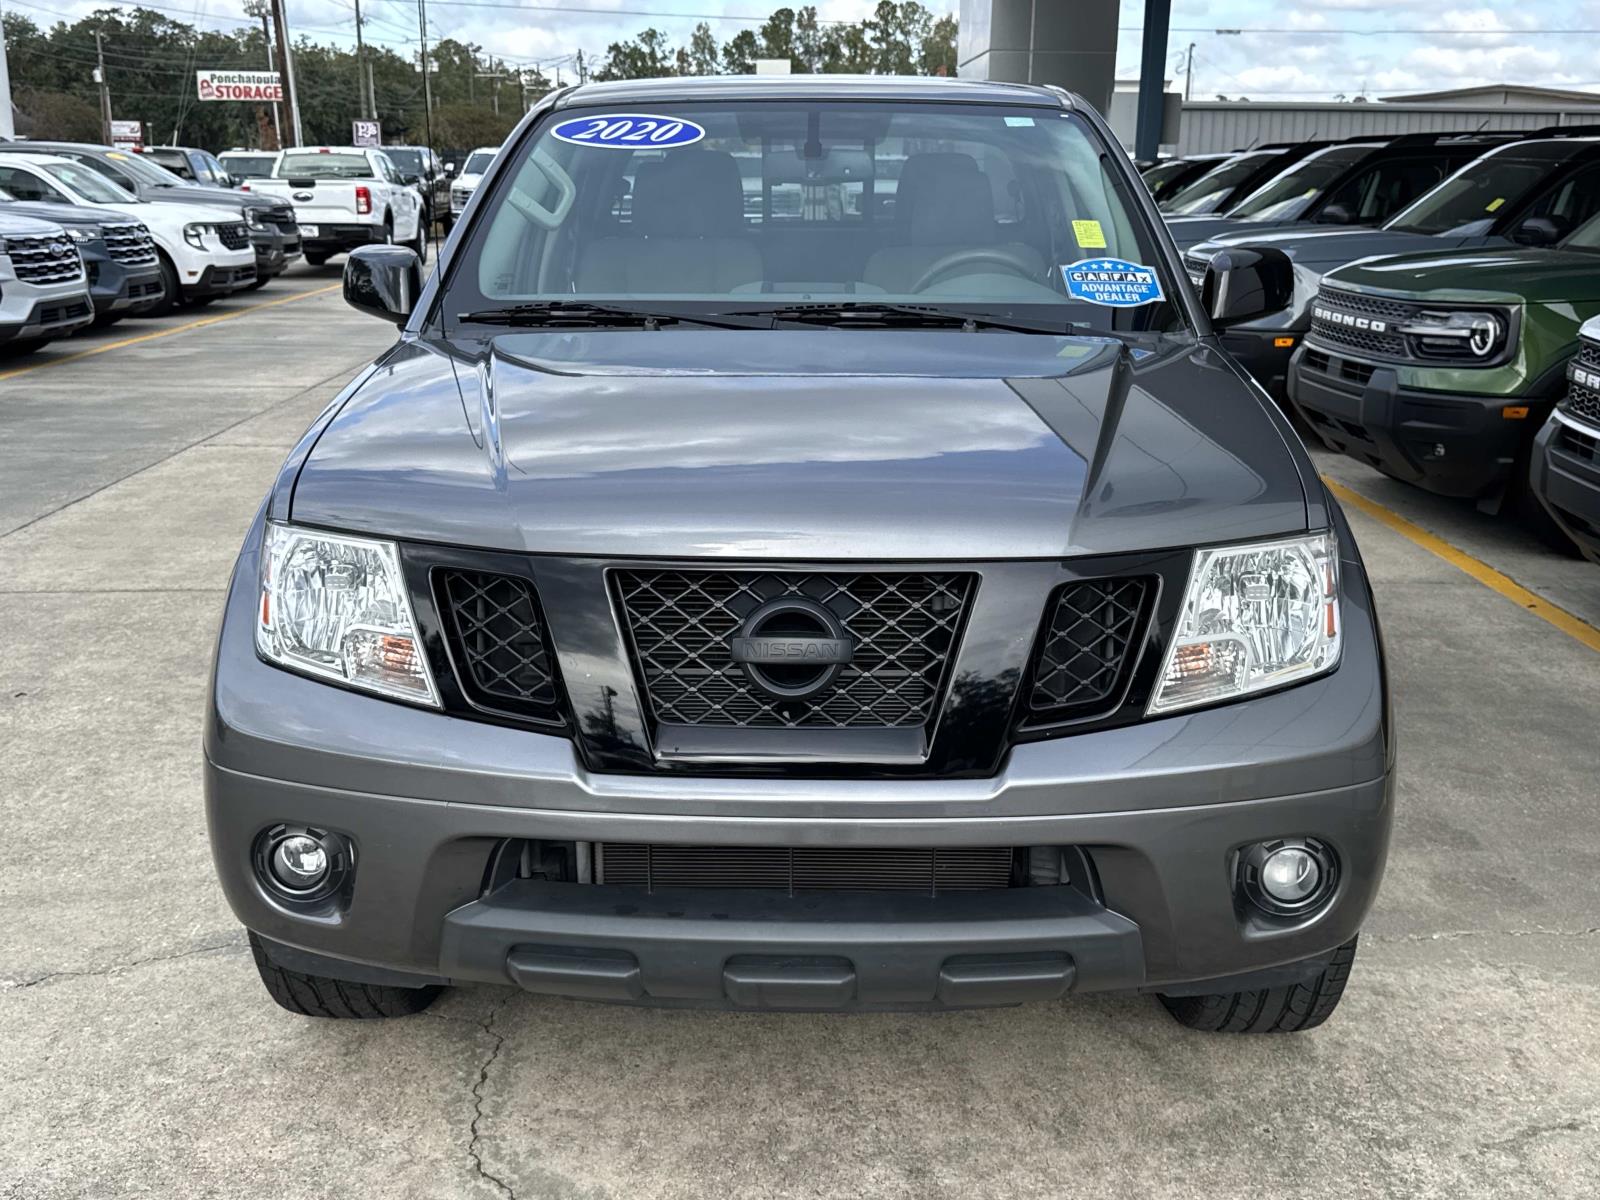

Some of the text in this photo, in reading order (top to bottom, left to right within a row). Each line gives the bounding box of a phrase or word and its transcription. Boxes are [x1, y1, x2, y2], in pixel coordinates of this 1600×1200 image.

[210, 73, 280, 84] Ponchatoula
[215, 85, 282, 98] STORAGE
[571, 120, 684, 142] 2020
[1072, 272, 1151, 283] CARFAX
[1082, 284, 1149, 293] ADVANTAGE
[1095, 293, 1140, 302] DEALER
[1314, 307, 1386, 332] BRONCO
[744, 642, 840, 658] NISSAN
